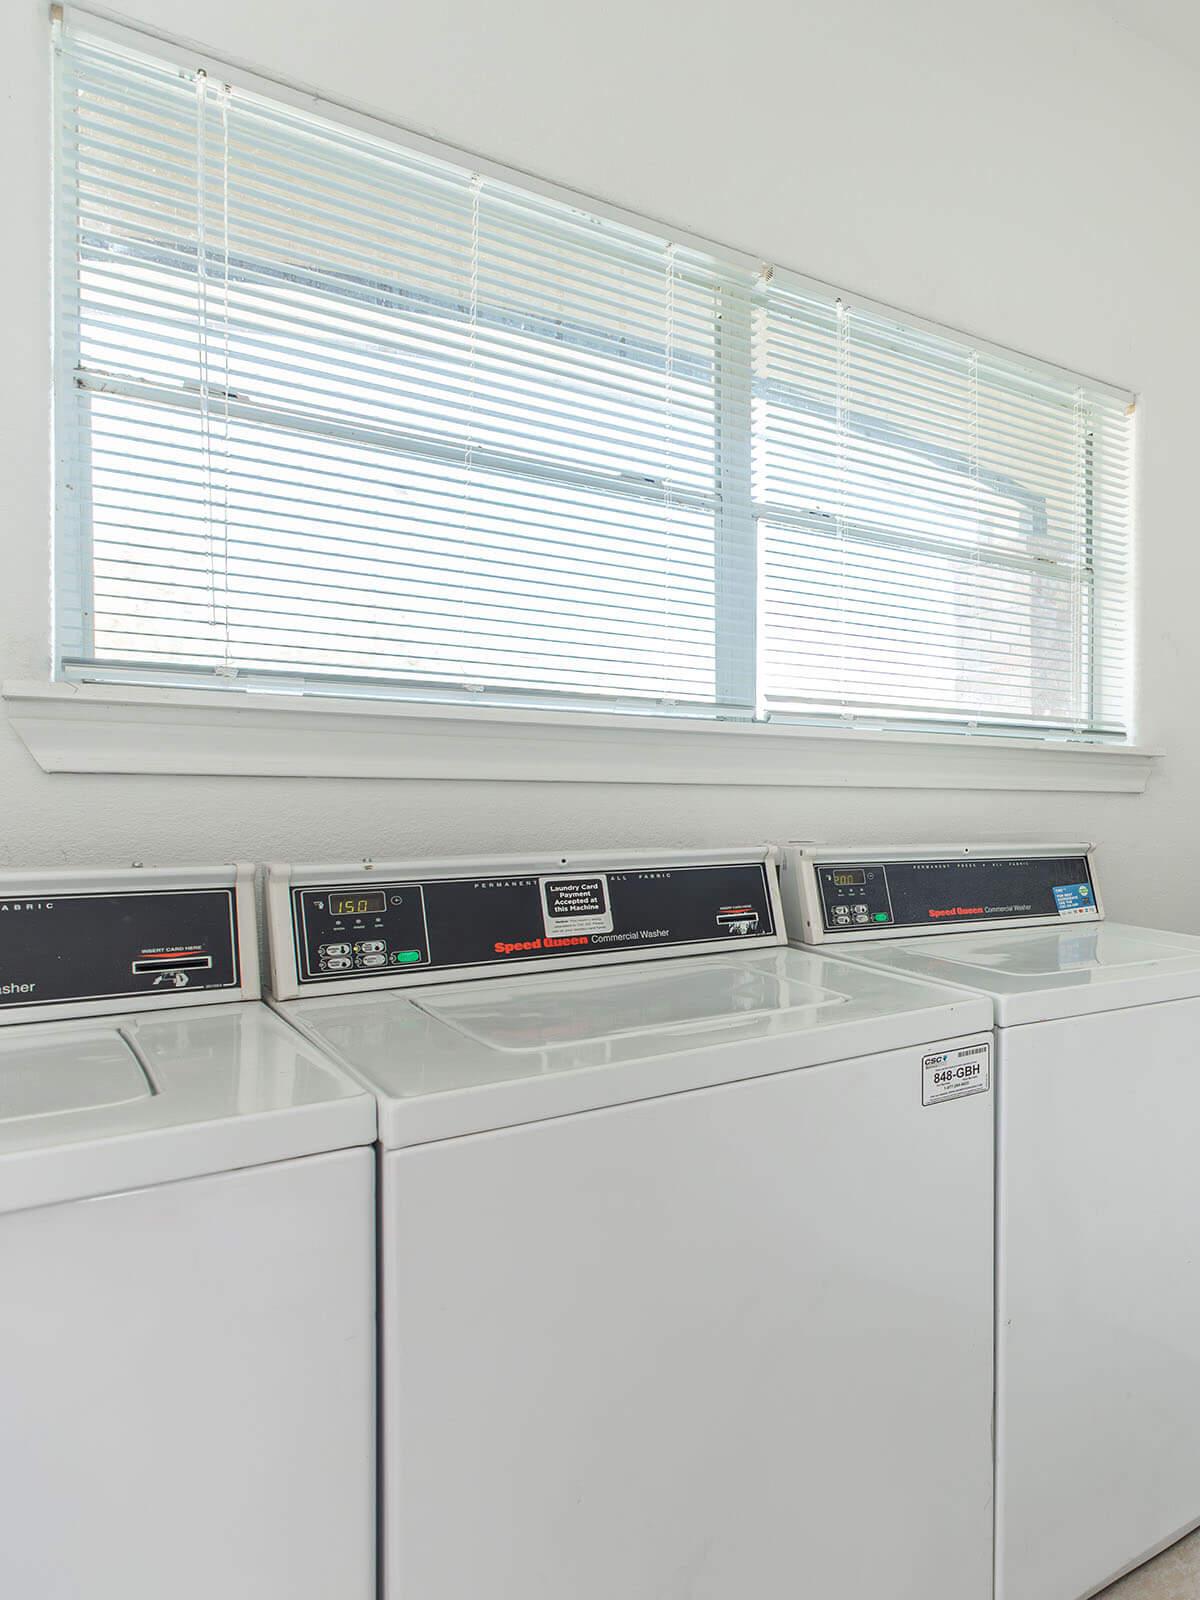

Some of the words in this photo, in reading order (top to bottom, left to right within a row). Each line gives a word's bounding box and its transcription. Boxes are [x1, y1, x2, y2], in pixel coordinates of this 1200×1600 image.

[474, 880, 538, 889] PERMANENT
[495, 938, 542, 954] Speed
[543, 936, 588, 950] Queen
[591, 930, 639, 944] Commercial
[640, 928, 670, 939] Washer
[0, 983, 35, 994] sher
[934, 1064, 980, 1083] 848-GBH
